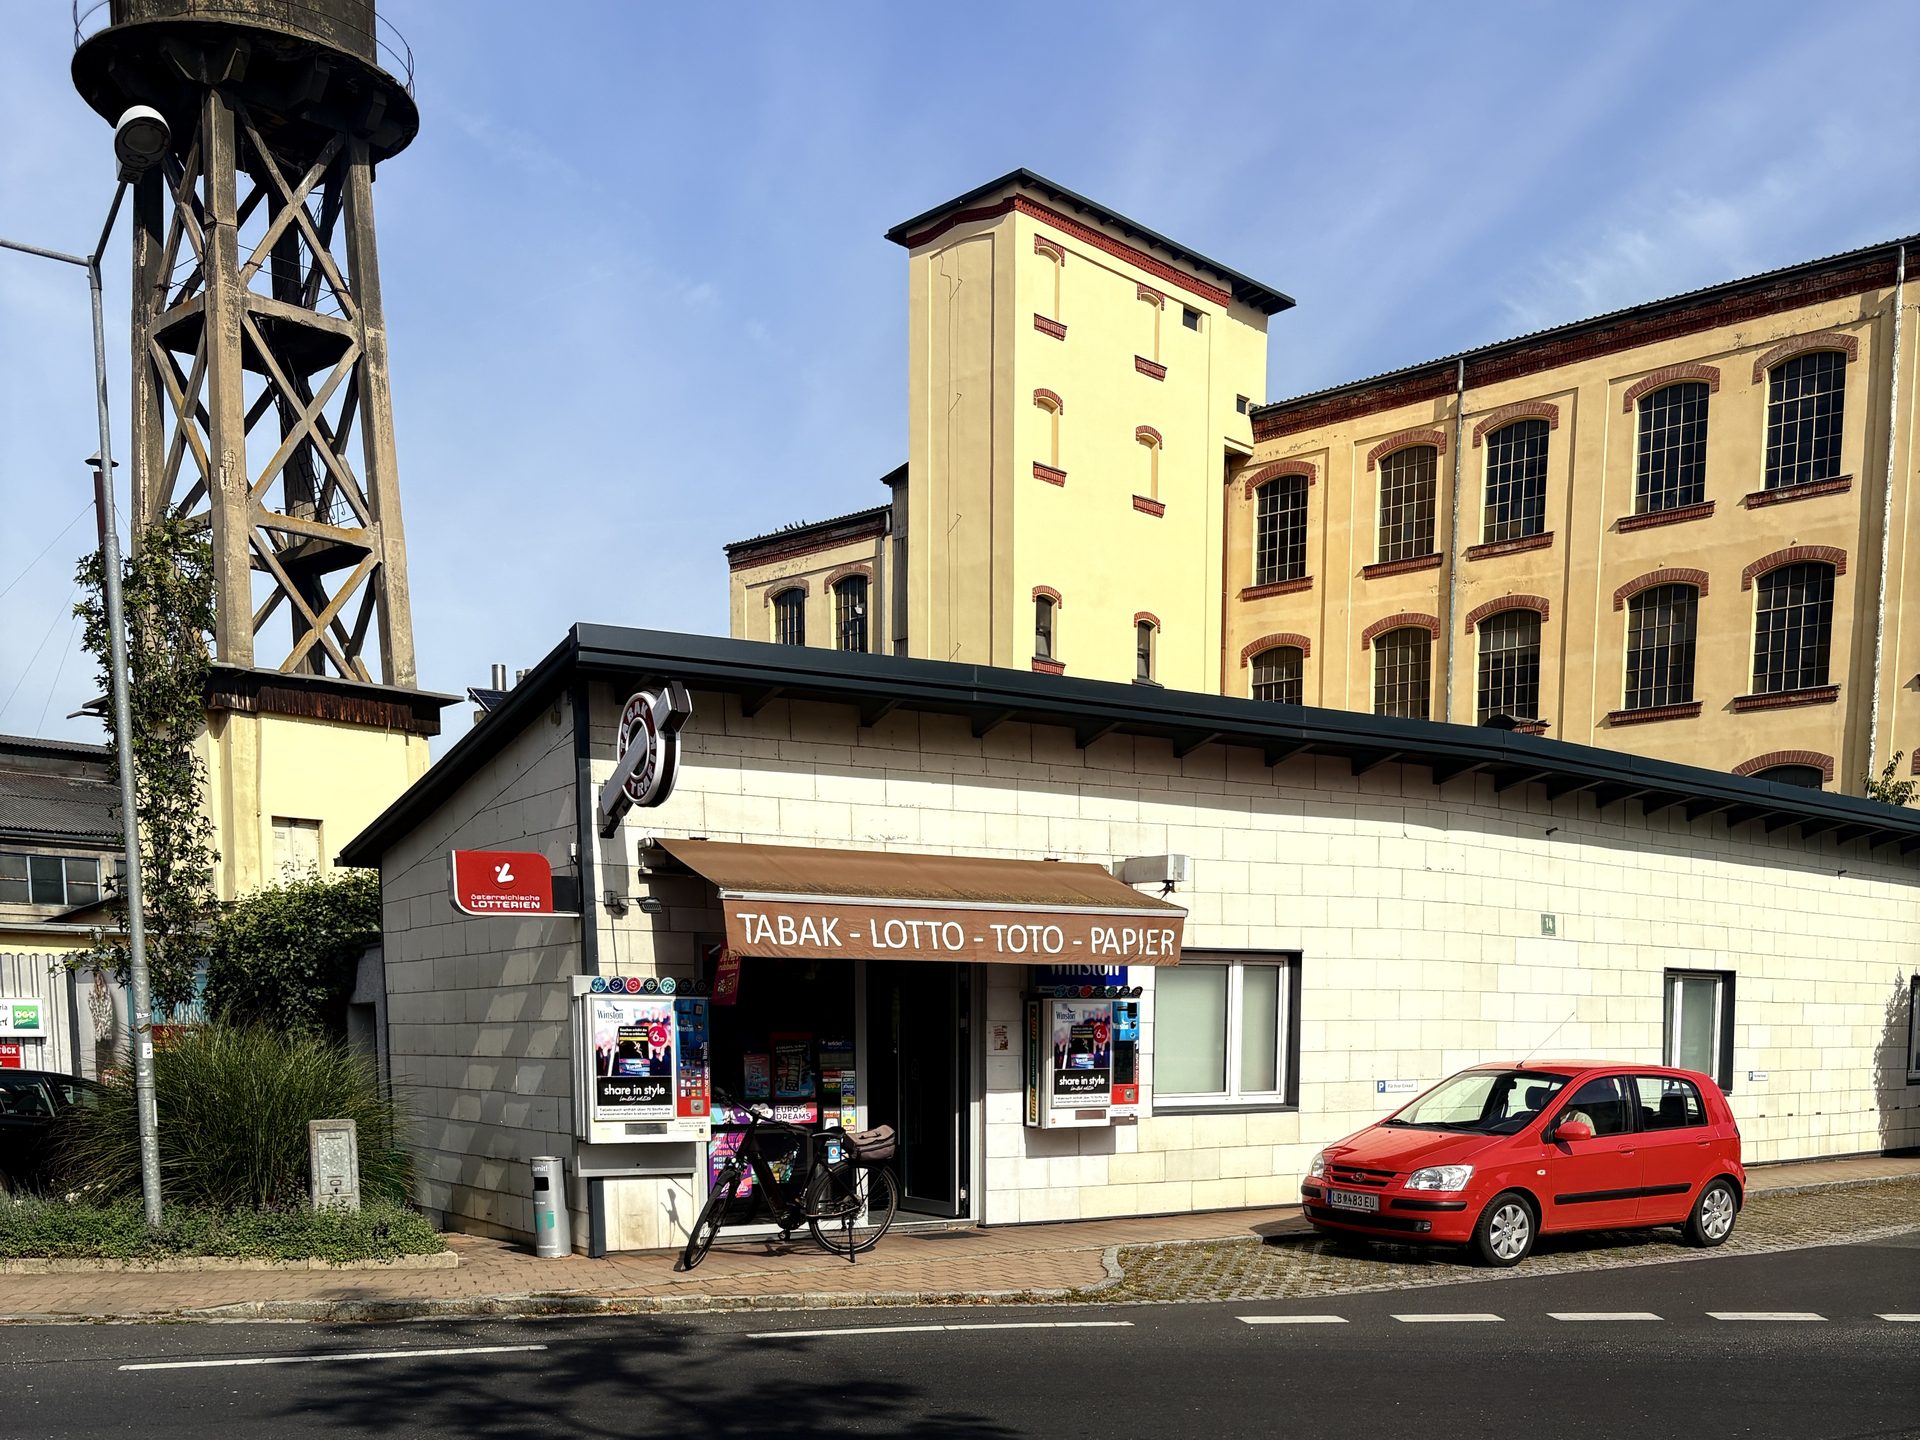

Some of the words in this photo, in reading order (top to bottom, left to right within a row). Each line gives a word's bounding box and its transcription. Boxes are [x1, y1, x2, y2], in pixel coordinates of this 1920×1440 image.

[471, 900, 541, 909] LOTTERIEN
[736, 912, 842, 947] TABAK
[870, 918, 965, 952] LOTTO
[989, 923, 1064, 954] TOTO
[1090, 926, 1175, 956] PAPIER
[597, 1009, 624, 1020] Winston
[1059, 1075, 1080, 1086] share
[1080, 1075, 1088, 1085] in
[1088, 1074, 1105, 1088] style
[604, 1083, 632, 1096] share
[633, 1084, 642, 1095] in
[644, 1083, 666, 1098] style
